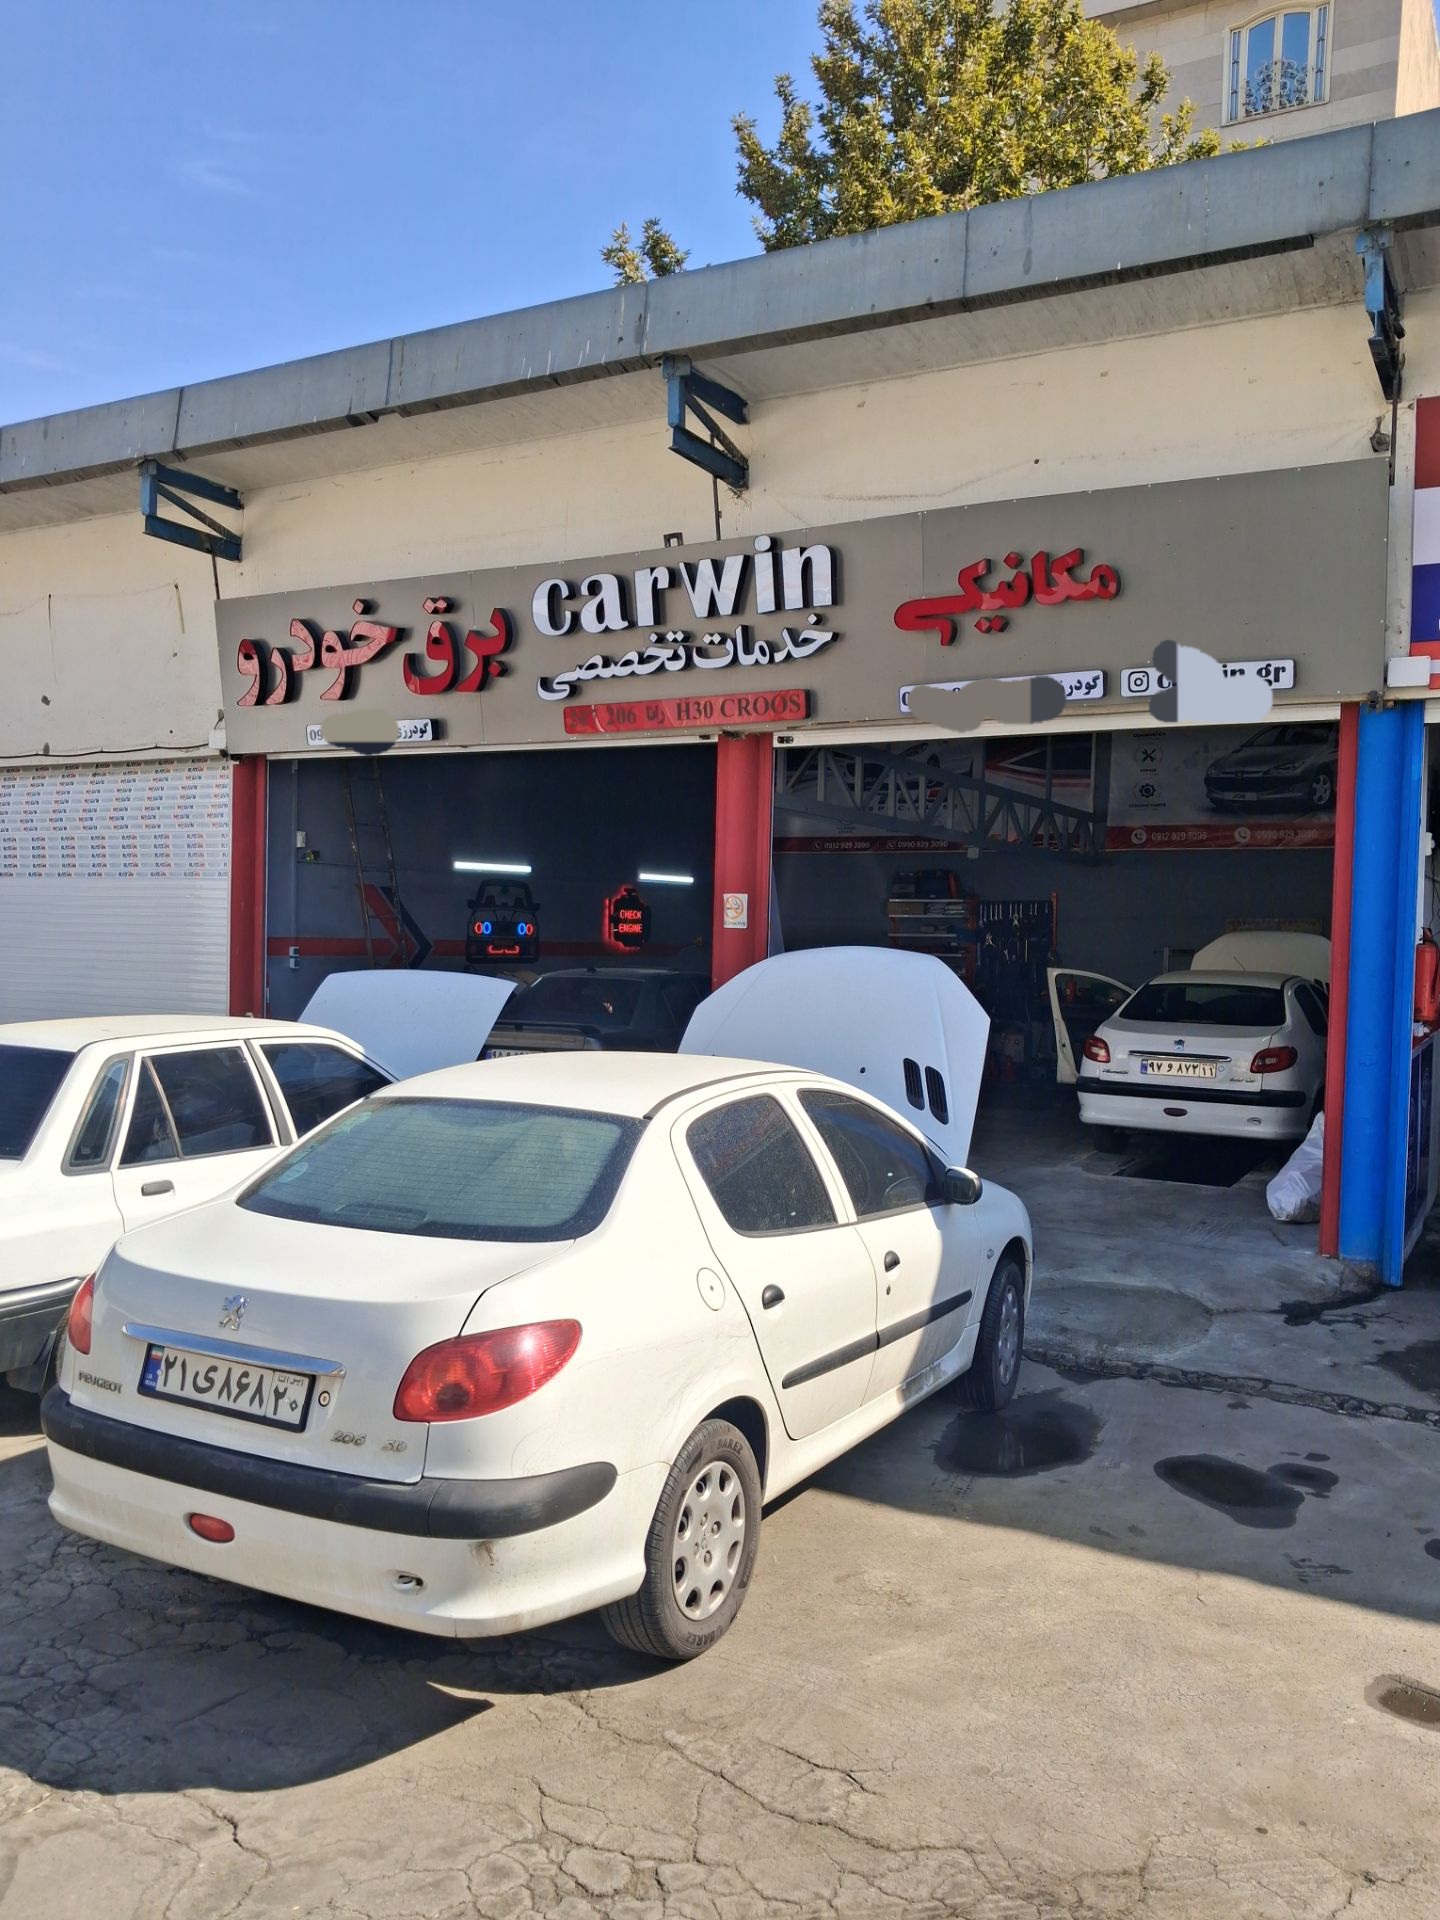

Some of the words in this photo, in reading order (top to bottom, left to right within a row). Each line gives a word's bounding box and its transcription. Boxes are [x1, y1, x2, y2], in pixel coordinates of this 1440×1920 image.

[531, 535, 834, 637] carwin
[894, 547, 1120, 646] مکانیکی
[237, 599, 402, 707] خودرو
[403, 596, 510, 696] برق
[536, 628, 687, 701] تخصصی
[696, 611, 836, 668] خدمات
[676, 701, 714, 721] H30
[720, 693, 801, 718] CROOS
[618, 923, 643, 934] ENGINE
[619, 909, 642, 920] CHECK
[79, 1371, 123, 1394] PEUGEOT
[330, 1430, 367, 1447] 206
